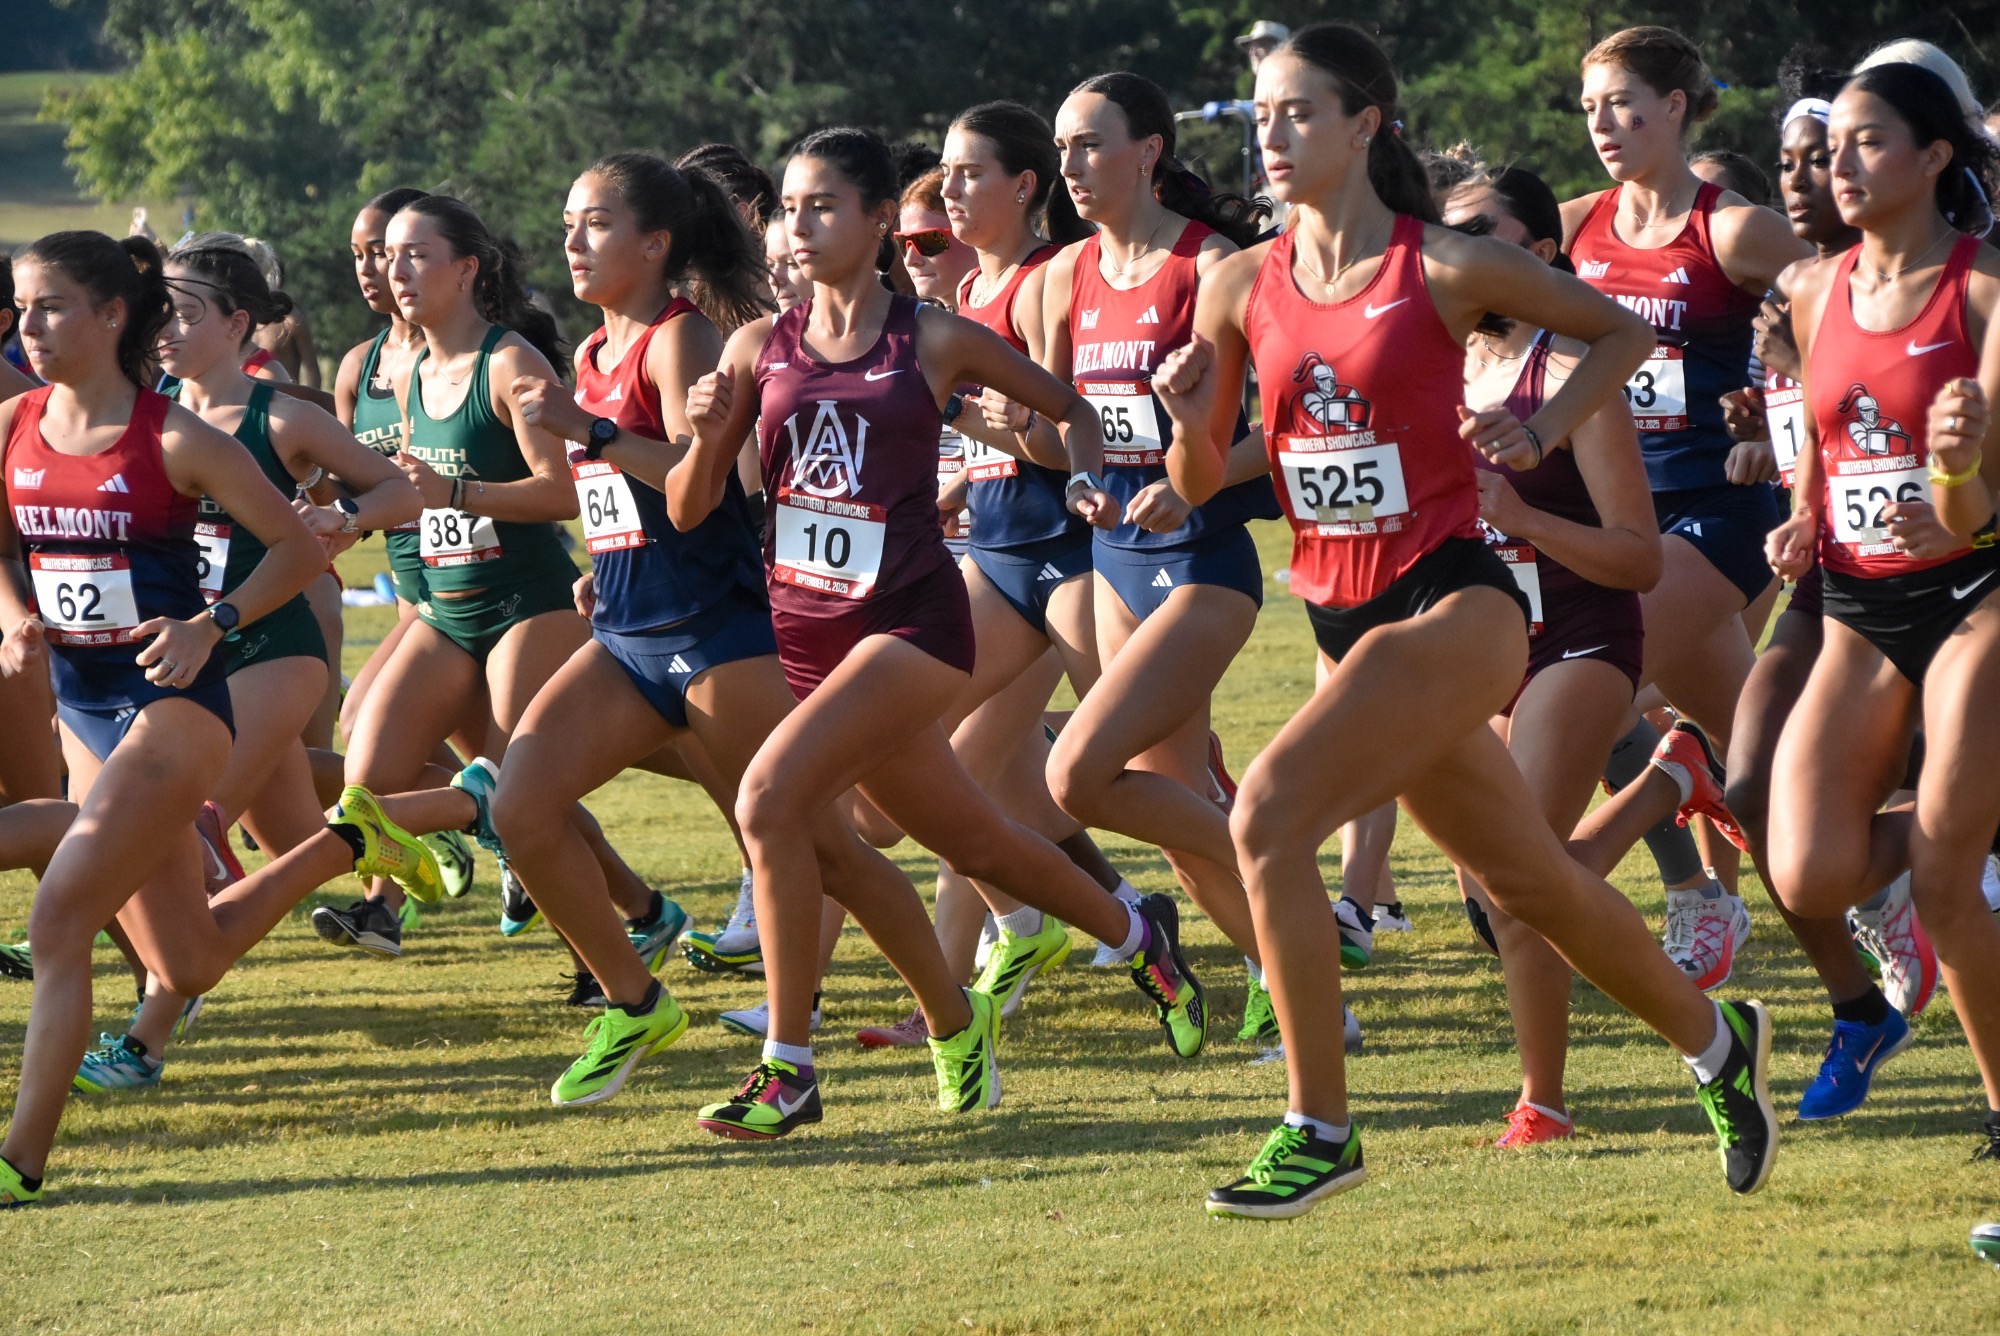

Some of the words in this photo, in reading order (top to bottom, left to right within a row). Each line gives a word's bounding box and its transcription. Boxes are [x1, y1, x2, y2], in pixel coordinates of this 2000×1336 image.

[1616, 294, 1687, 331] MONT
[1074, 341, 1155, 376] BELMONT
[1622, 370, 1657, 408] 3
[1101, 405, 1133, 443] 65
[1288, 437, 1326, 452] SOUTHERN
[1326, 430, 1377, 450] SHOWCASE
[408, 446, 466, 461] SOUTH
[1837, 461, 1873, 475] SOUTHERN
[1873, 454, 1918, 472] SHOWCASE
[428, 462, 479, 477] RIDA
[937, 460, 962, 472] UTHERN
[1298, 460, 1384, 510] 525
[587, 485, 619, 528] 64
[789, 493, 825, 512] SOUTHERN
[826, 500, 871, 519] SHOWCASE
[14, 505, 132, 541] BELMONT
[429, 514, 481, 548] 387
[1317, 523, 1350, 536] SEPTEMBER
[1360, 521, 1377, 534] 2025
[803, 522, 851, 569] 10
[1497, 549, 1519, 562] CASE
[1858, 542, 1895, 557] SEPTEMBER
[40, 558, 71, 571] SOUTHERN
[71, 557, 112, 570] SHOWCASE
[795, 572, 825, 590] SEPTEMBER
[832, 581, 849, 594] 2025
[57, 582, 105, 622] 62
[95, 633, 112, 644] 2025
